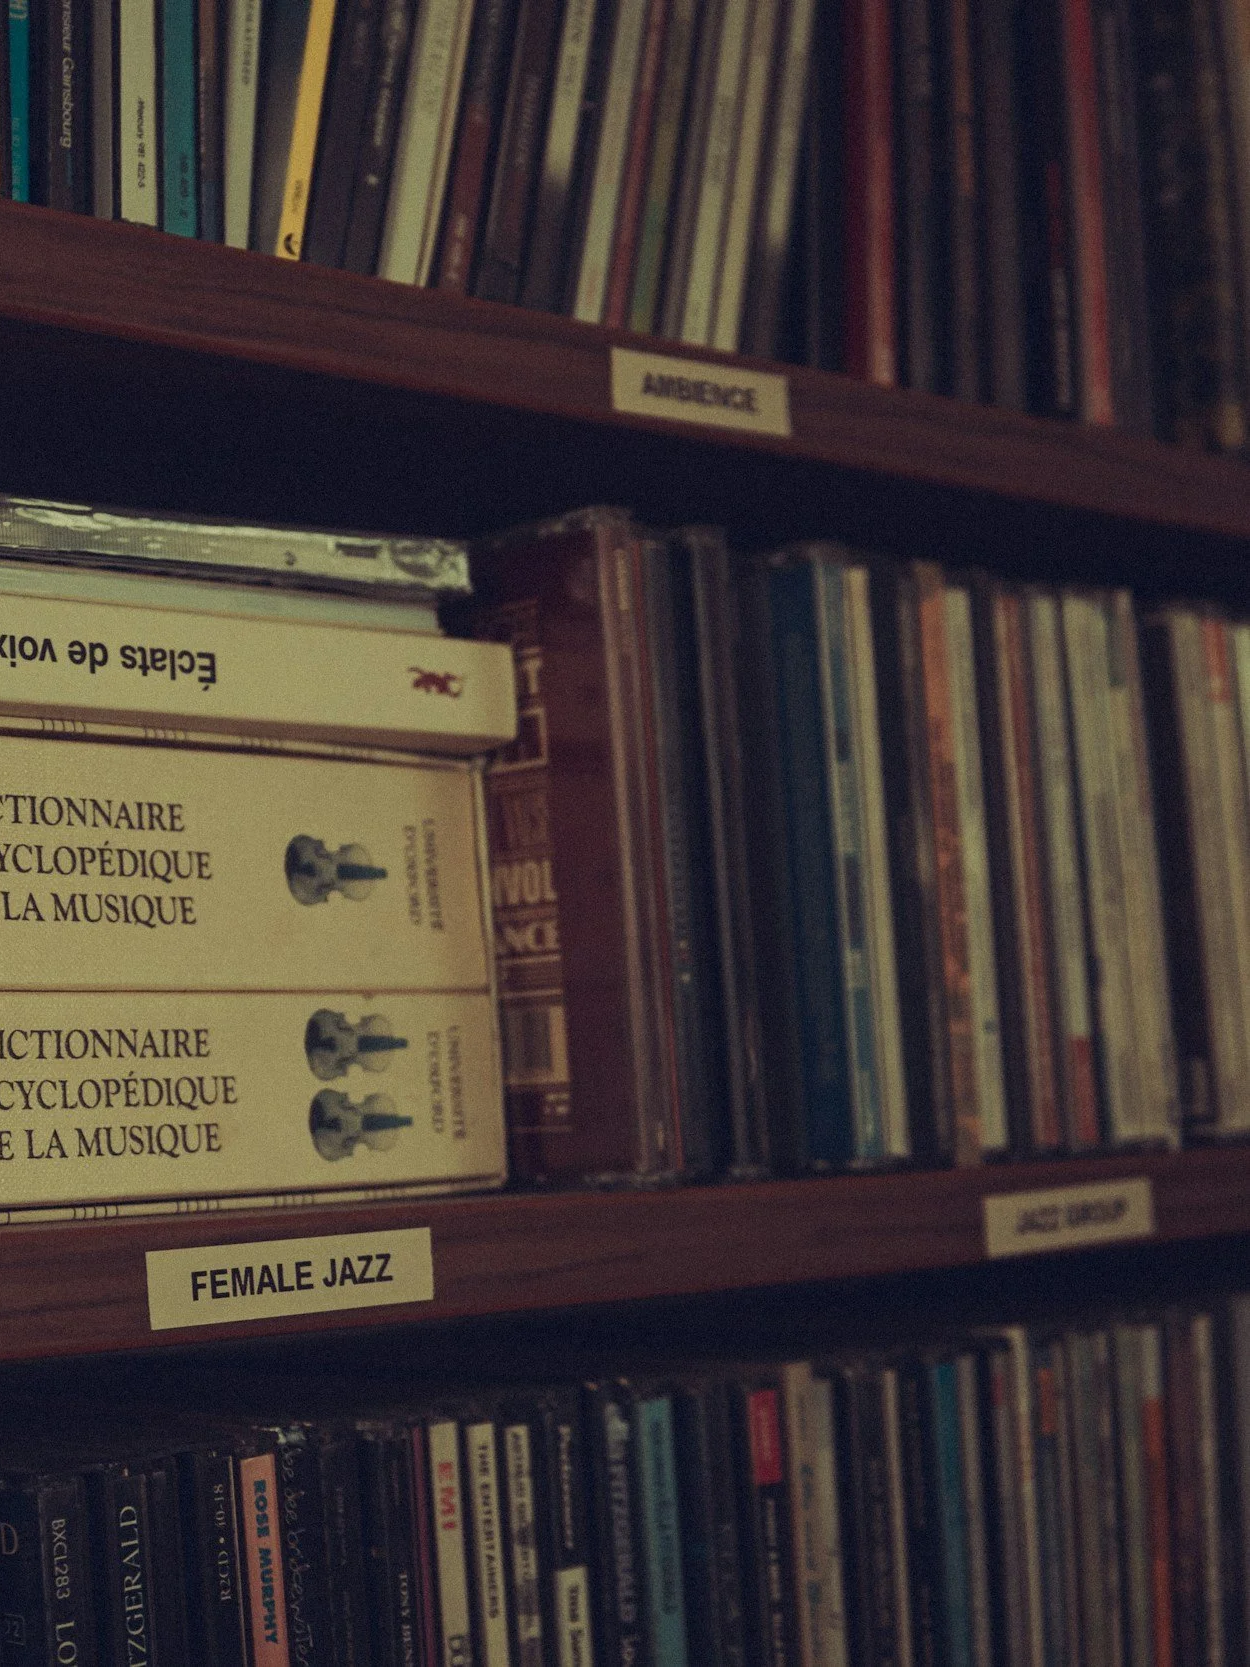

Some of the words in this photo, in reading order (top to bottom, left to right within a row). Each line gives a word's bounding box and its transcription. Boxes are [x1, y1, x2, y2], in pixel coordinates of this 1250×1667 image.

[59, 56, 75, 149] Gainsbourg
[642, 371, 757, 415] AMBIENCE
[67, 641, 109, 675] de
[119, 644, 218, 691] Éclats
[0, 890, 47, 922] LA
[49, 892, 198, 929] MUSIQUE
[22, 1127, 70, 1160] LA
[74, 1121, 223, 1160] MUSIQUE
[189, 1260, 314, 1302] FEMALE
[322, 1252, 394, 1288] JAZZ
[476, 1443, 489, 1478] THE
[253, 1479, 271, 1538] ROSE
[437, 1460, 459, 1531] EMI
[51, 1517, 71, 1601] BXCL283
[480, 1482, 501, 1619] ENTERTAINERS
[258, 1547, 279, 1645] MURPHY
